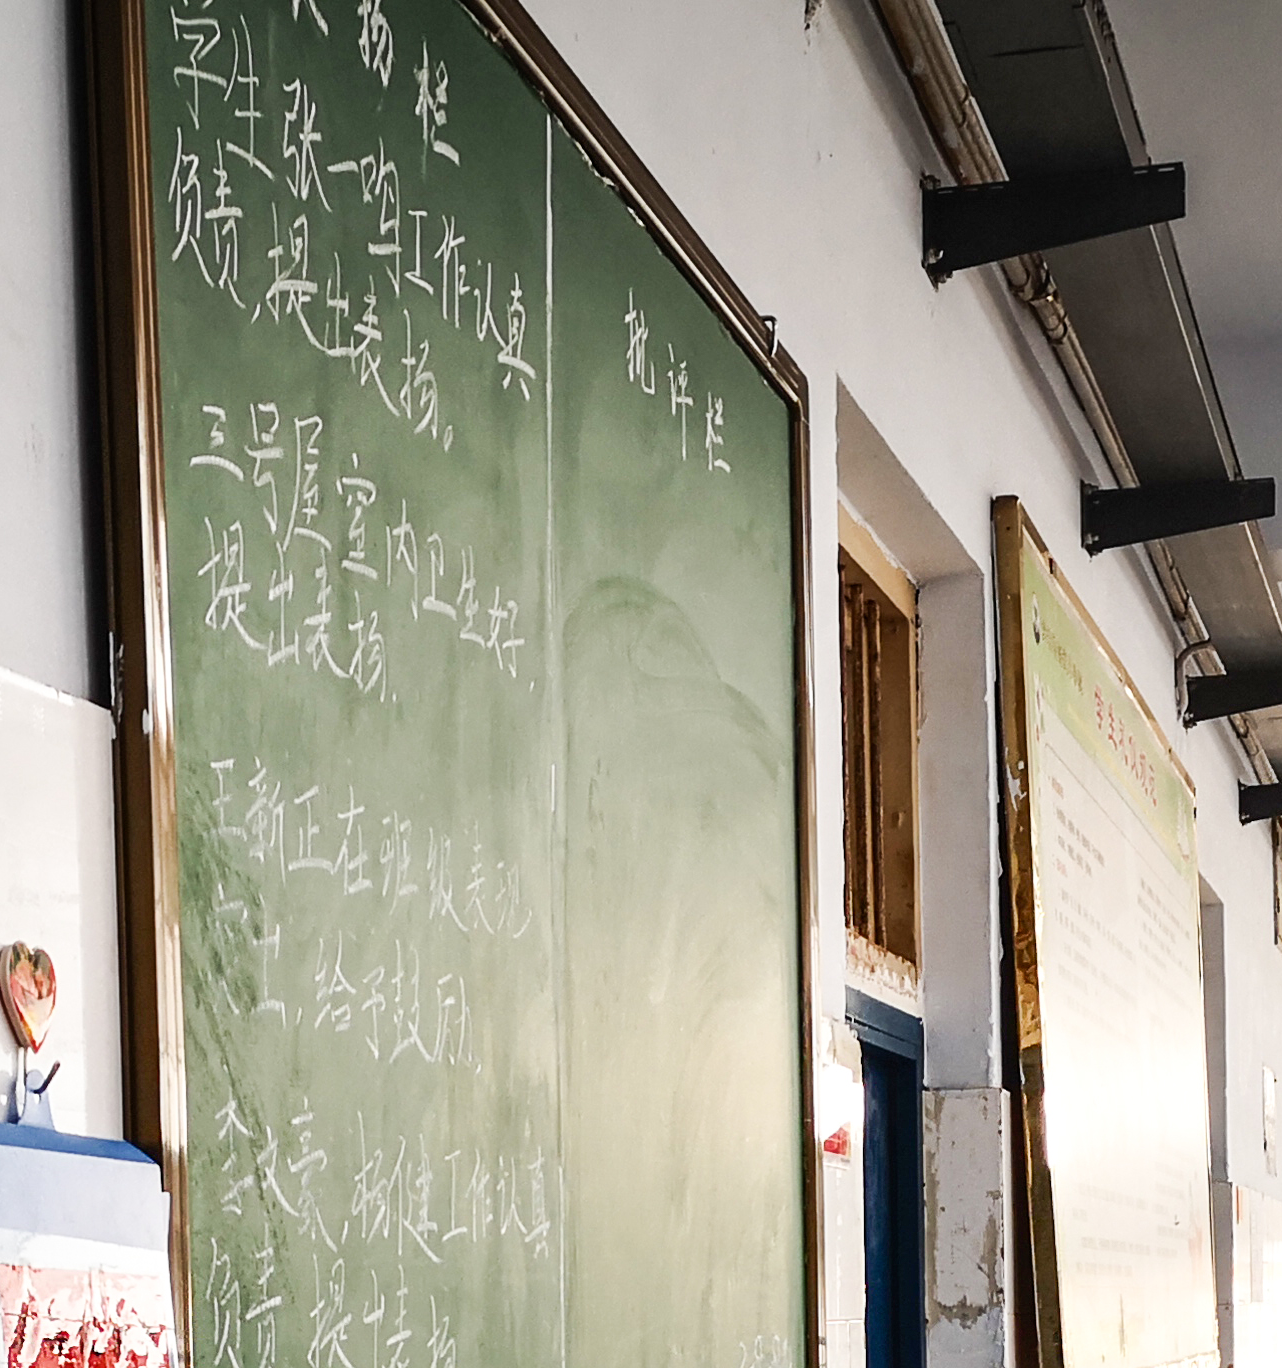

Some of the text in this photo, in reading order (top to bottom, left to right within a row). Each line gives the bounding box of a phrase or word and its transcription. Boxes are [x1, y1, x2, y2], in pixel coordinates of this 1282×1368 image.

[292, 0, 460, 167] 扬栏
[625, 286, 732, 474] 批评栏
